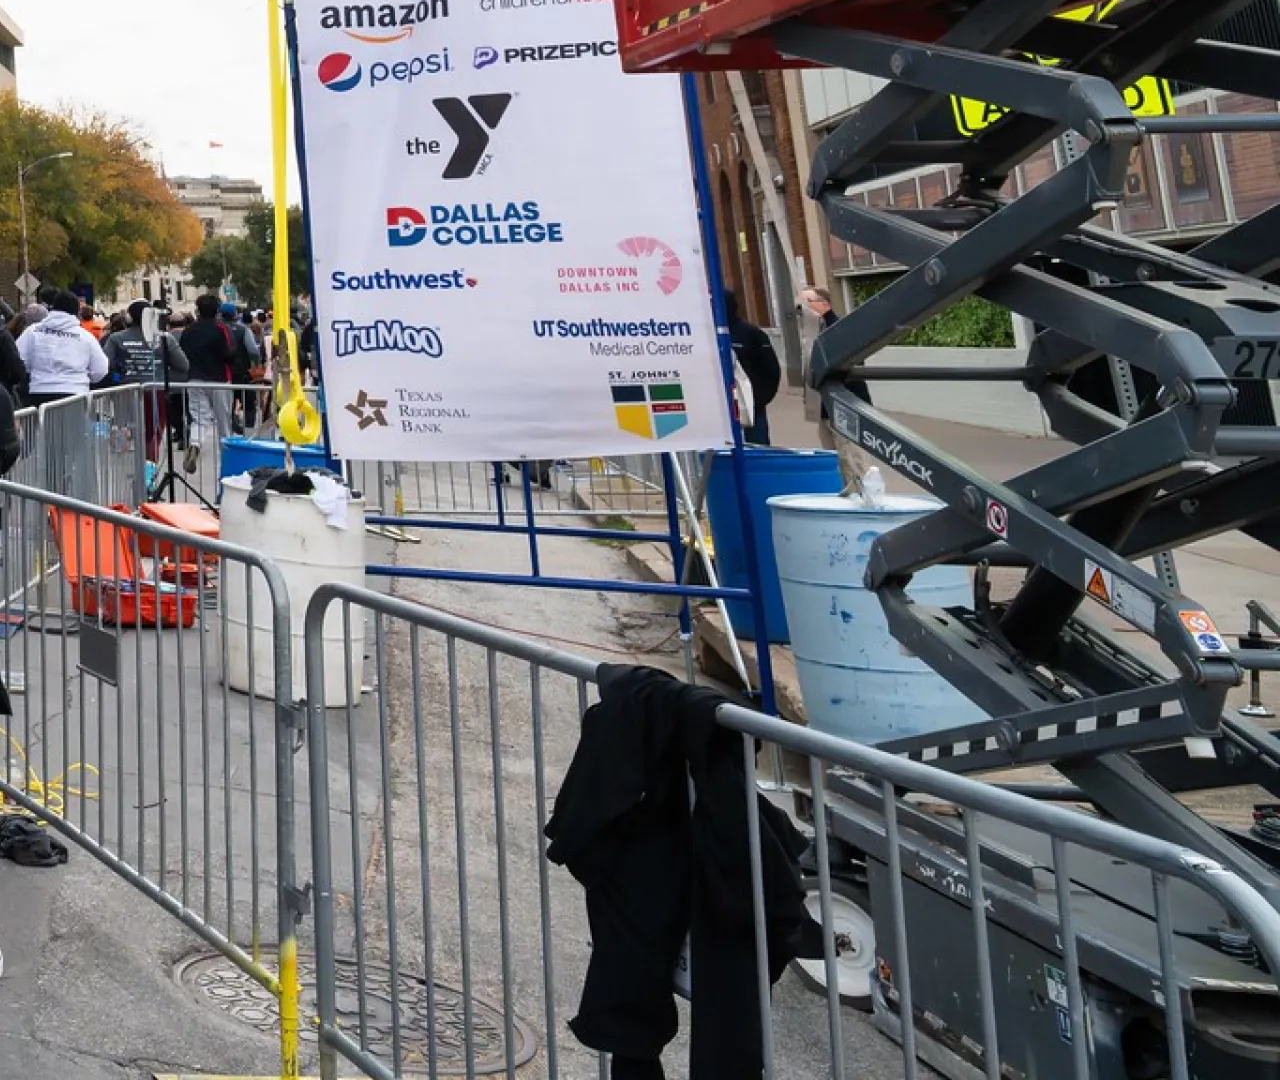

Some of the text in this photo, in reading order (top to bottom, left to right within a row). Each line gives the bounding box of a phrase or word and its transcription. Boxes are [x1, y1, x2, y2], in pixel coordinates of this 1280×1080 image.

[504, 41, 617, 63] PRIZEPIC
[370, 47, 450, 88] pepsi
[406, 137, 440, 155] the
[430, 201, 539, 222] DALLAS
[432, 223, 563, 245] COLLEGE
[331, 269, 464, 292] Southwest
[557, 267, 638, 279] DOWNTOWN
[559, 280, 640, 293] DALLAS INC
[331, 320, 443, 358] TruMoo
[590, 340, 693, 357] Medical Center
[608, 370, 681, 380] ST. JOHN'S
[862, 430, 934, 487] SKYJACK
